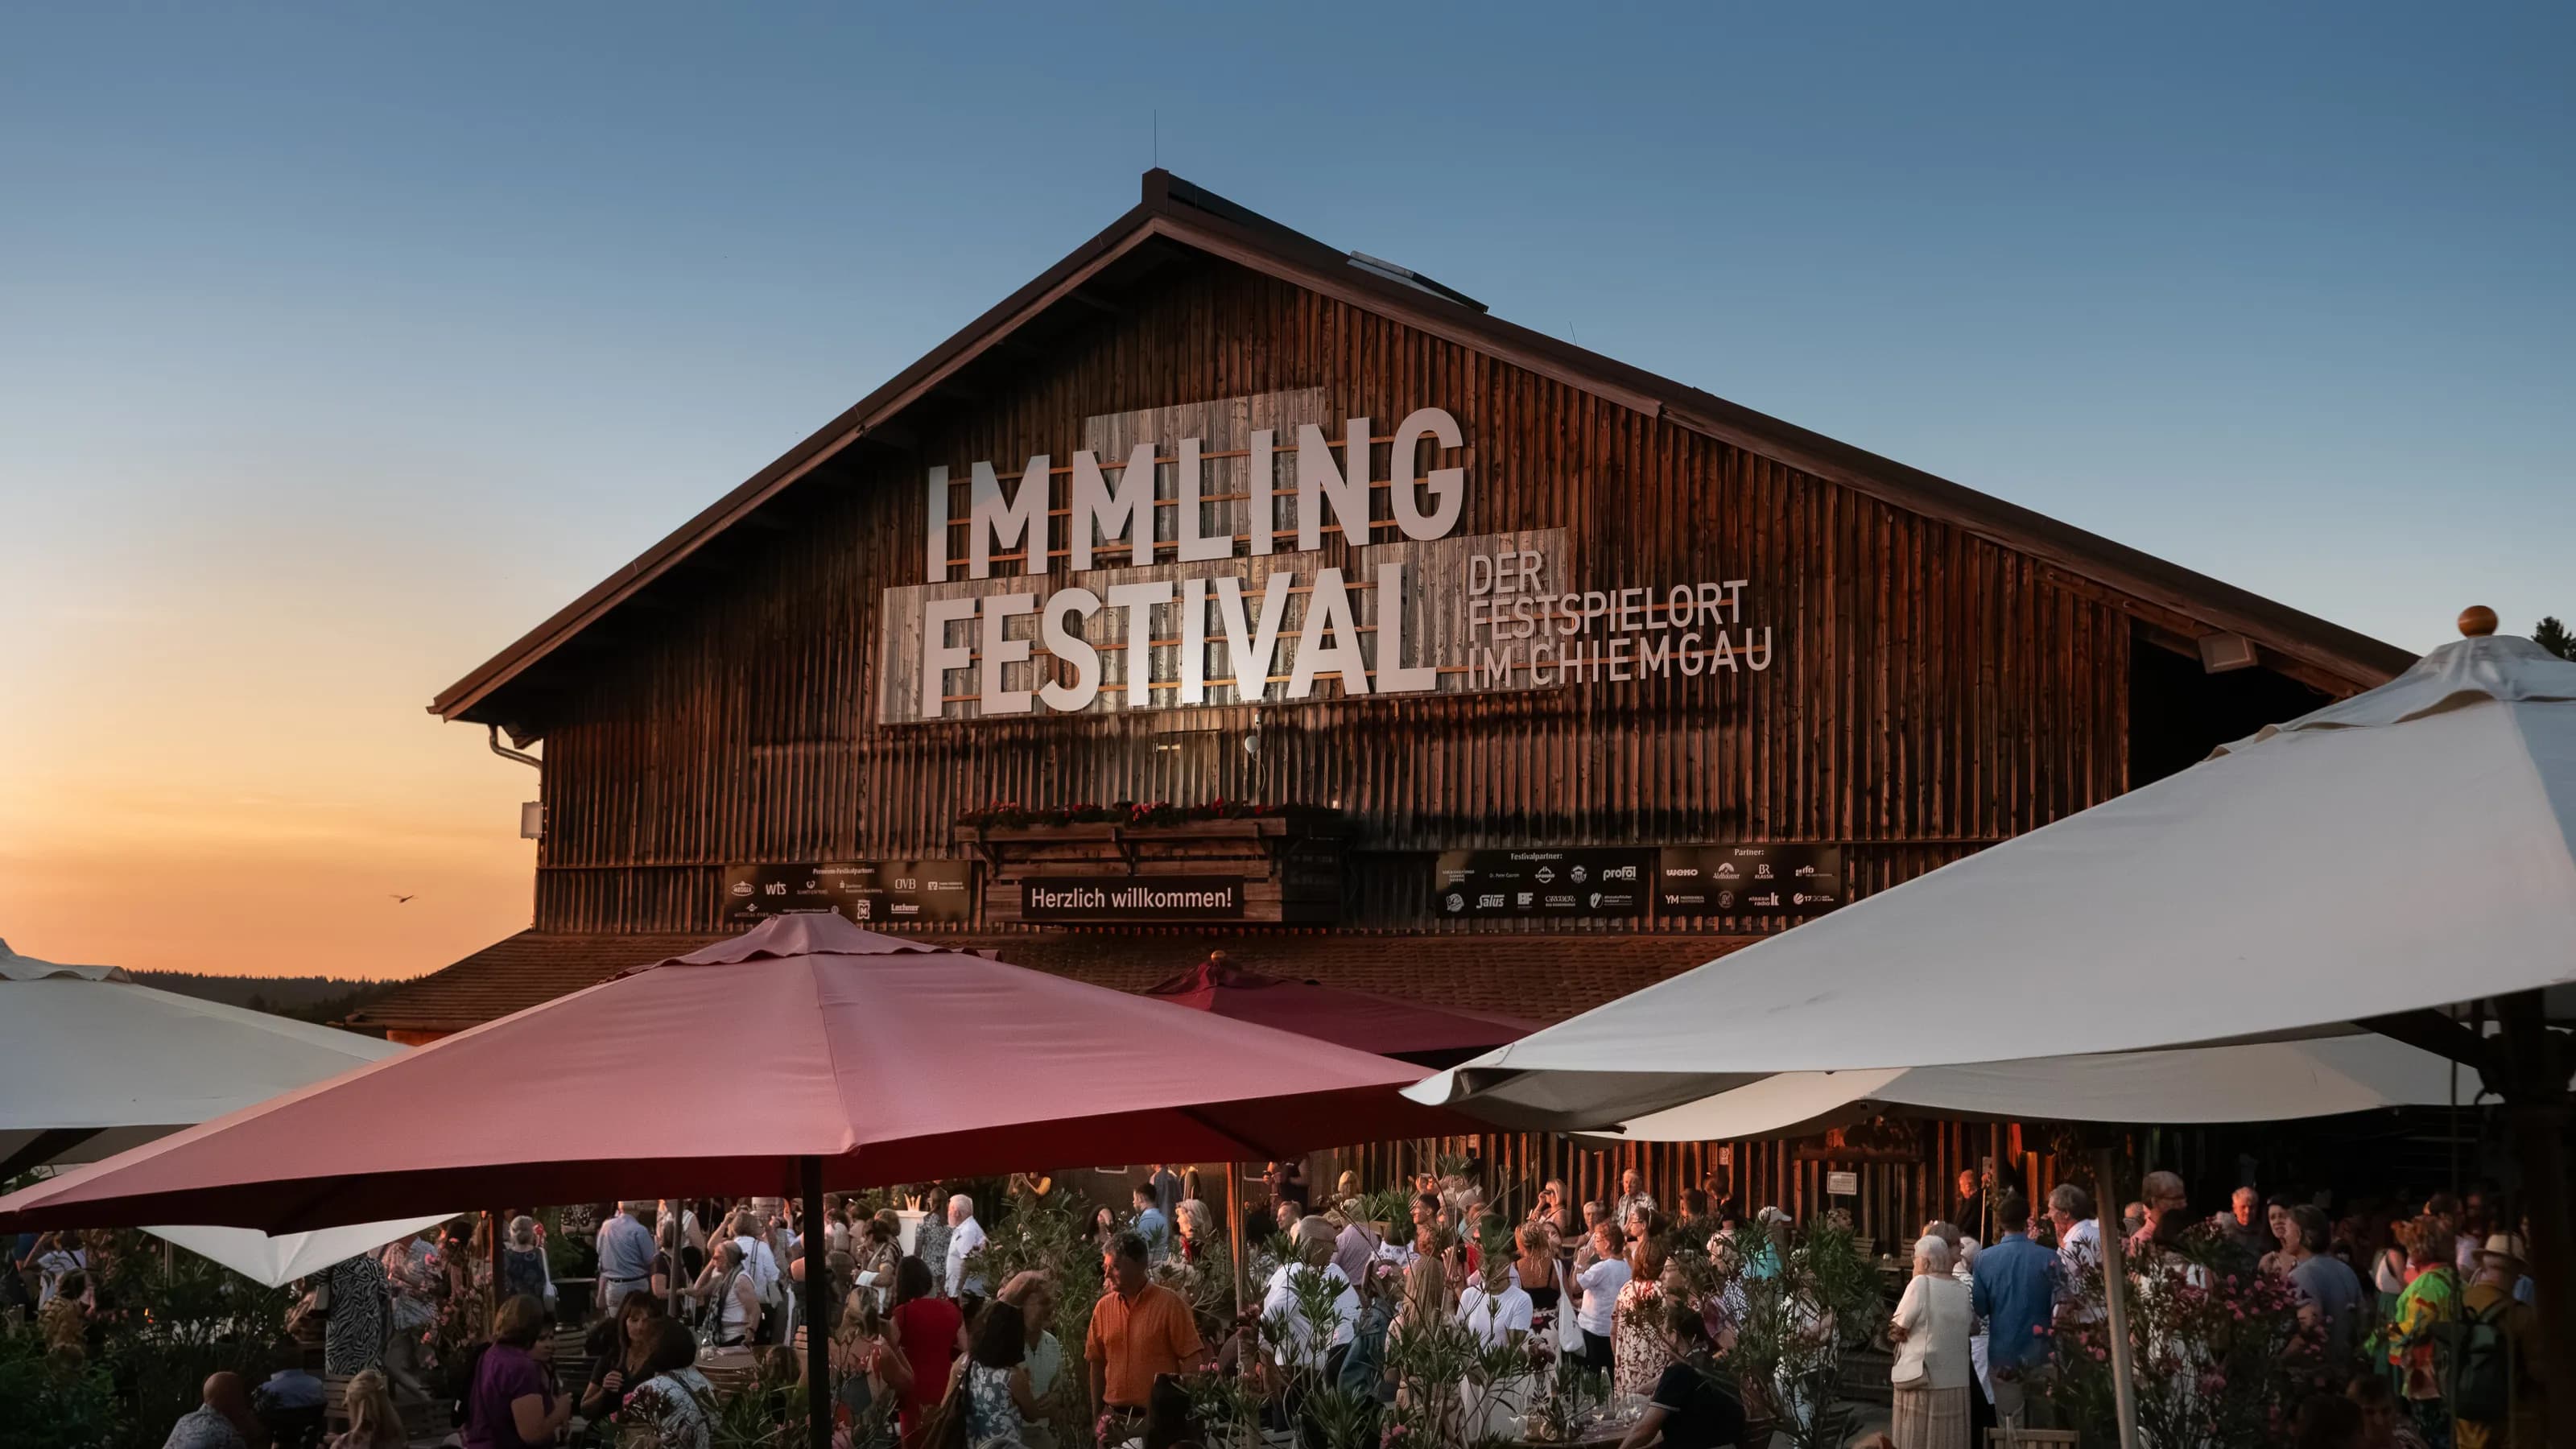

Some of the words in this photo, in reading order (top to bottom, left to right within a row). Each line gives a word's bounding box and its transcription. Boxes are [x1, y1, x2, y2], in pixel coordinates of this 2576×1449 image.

[927, 407, 1464, 583] IMMLING
[1469, 549, 1542, 597] DER
[1469, 578, 1748, 642] FESTSPIELORT
[922, 562, 1438, 718] FESTIVAL
[1469, 645, 1513, 690] IM
[1530, 625, 1772, 685] CHIEMGAU
[1510, 852, 1563, 861] Festivalpartner:
[1734, 848, 1764, 857] Partner:
[1758, 864, 1770, 874] BR
[766, 881, 786, 895] wts
[894, 878, 916, 890] OVB
[1031, 887, 1105, 907] Herzlich
[1111, 887, 1232, 908] willkommen!
[1476, 894, 1505, 909] Salus
[1665, 895, 1679, 904] YM
